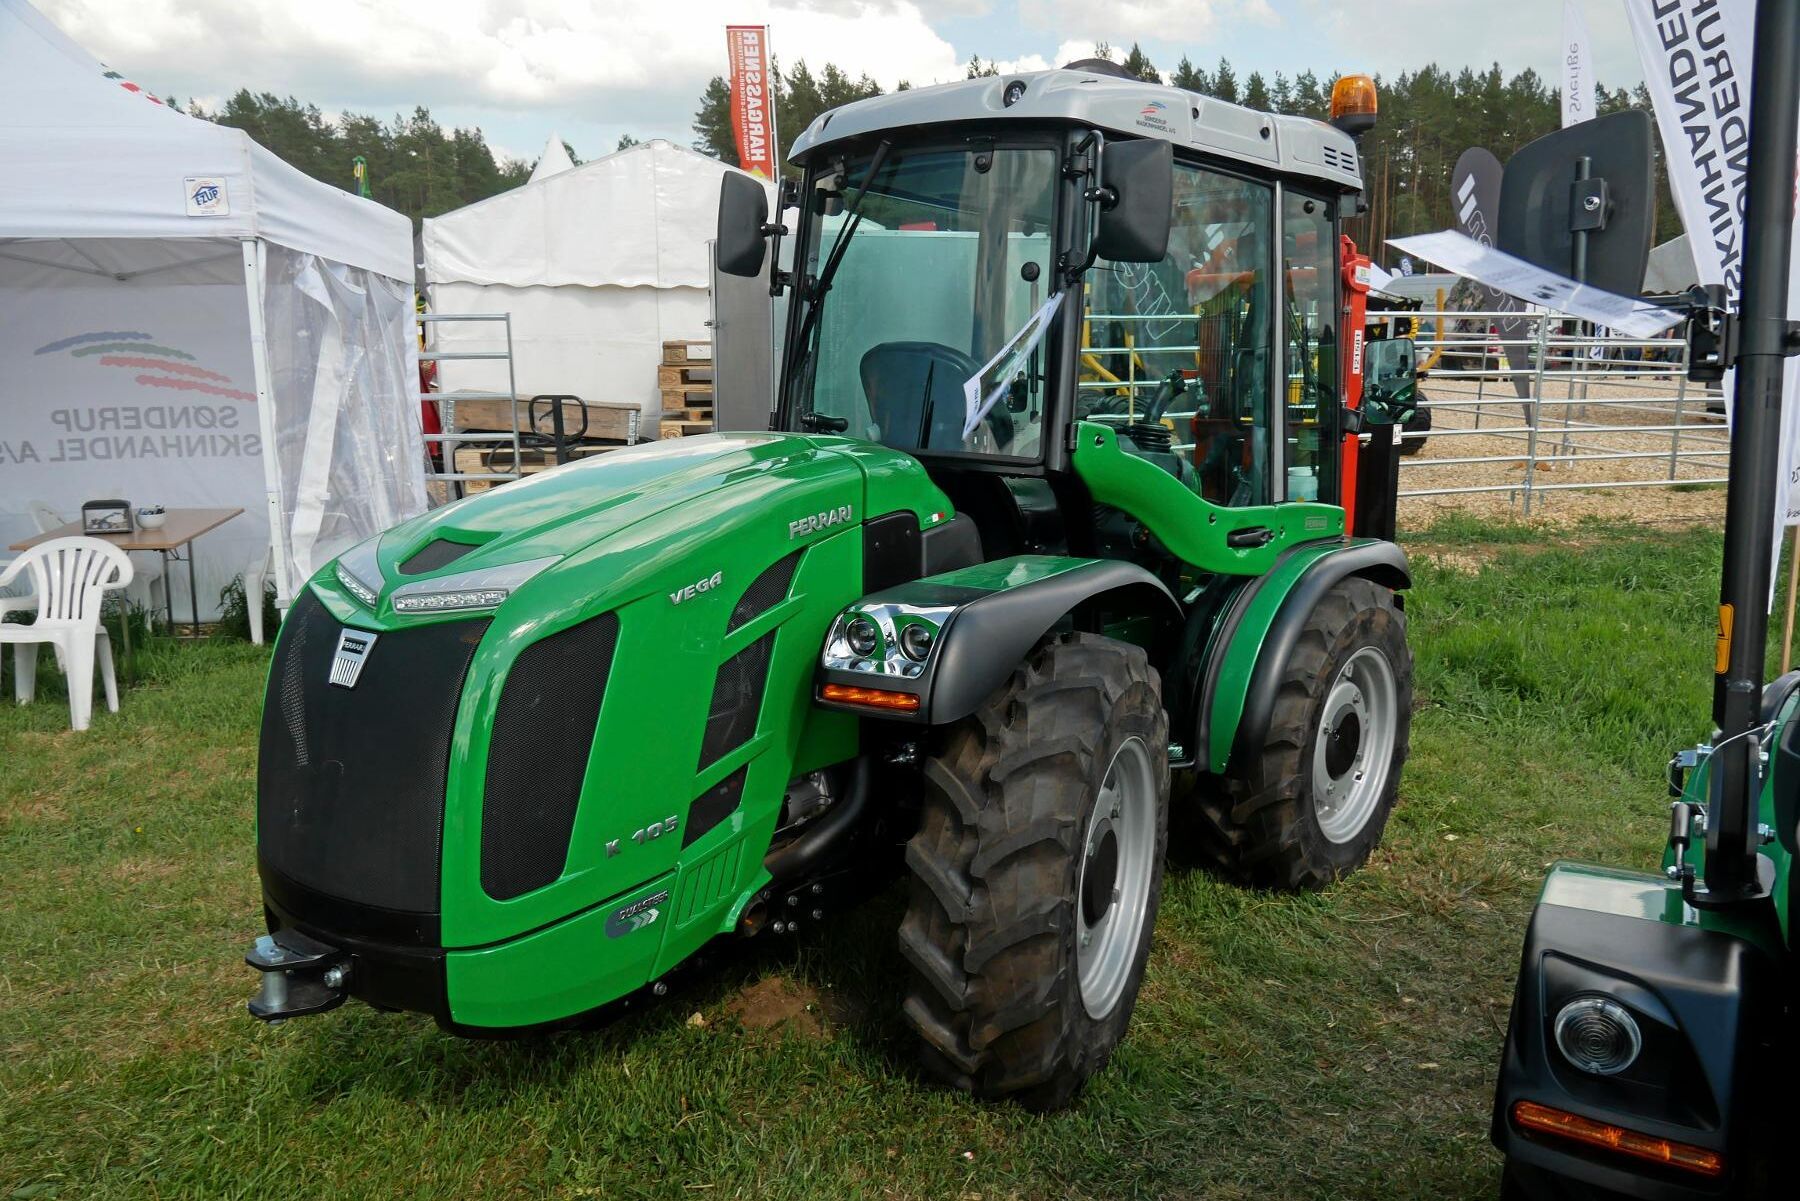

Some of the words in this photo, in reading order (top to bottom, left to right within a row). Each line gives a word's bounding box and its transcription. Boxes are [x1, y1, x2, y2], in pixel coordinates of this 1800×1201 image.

[789, 504, 852, 540] FERRARI
[670, 570, 723, 606] VEGA
[604, 838, 621, 859] K
[631, 814, 678, 846] 105
